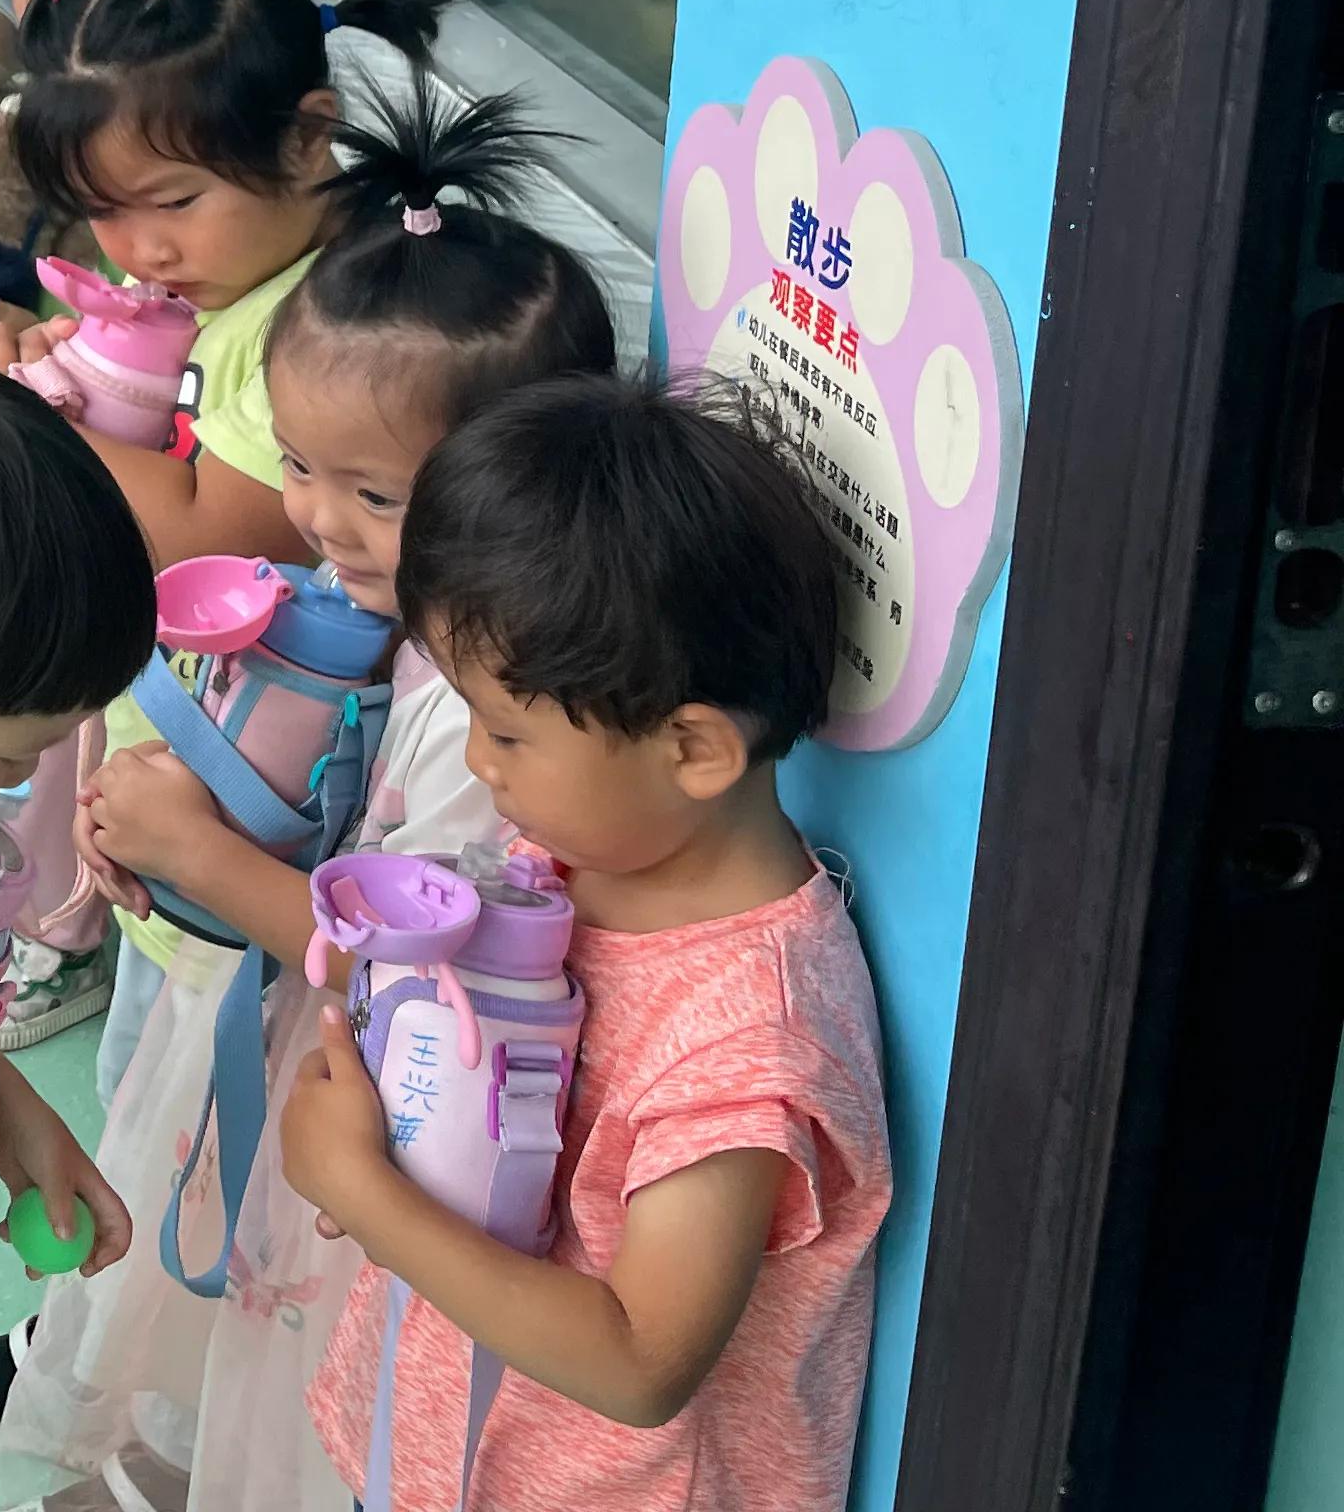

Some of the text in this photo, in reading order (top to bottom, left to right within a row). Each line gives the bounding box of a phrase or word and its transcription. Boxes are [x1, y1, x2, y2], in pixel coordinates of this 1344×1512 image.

[785, 196, 853, 290] 散步
[769, 267, 860, 375] 观察要点
